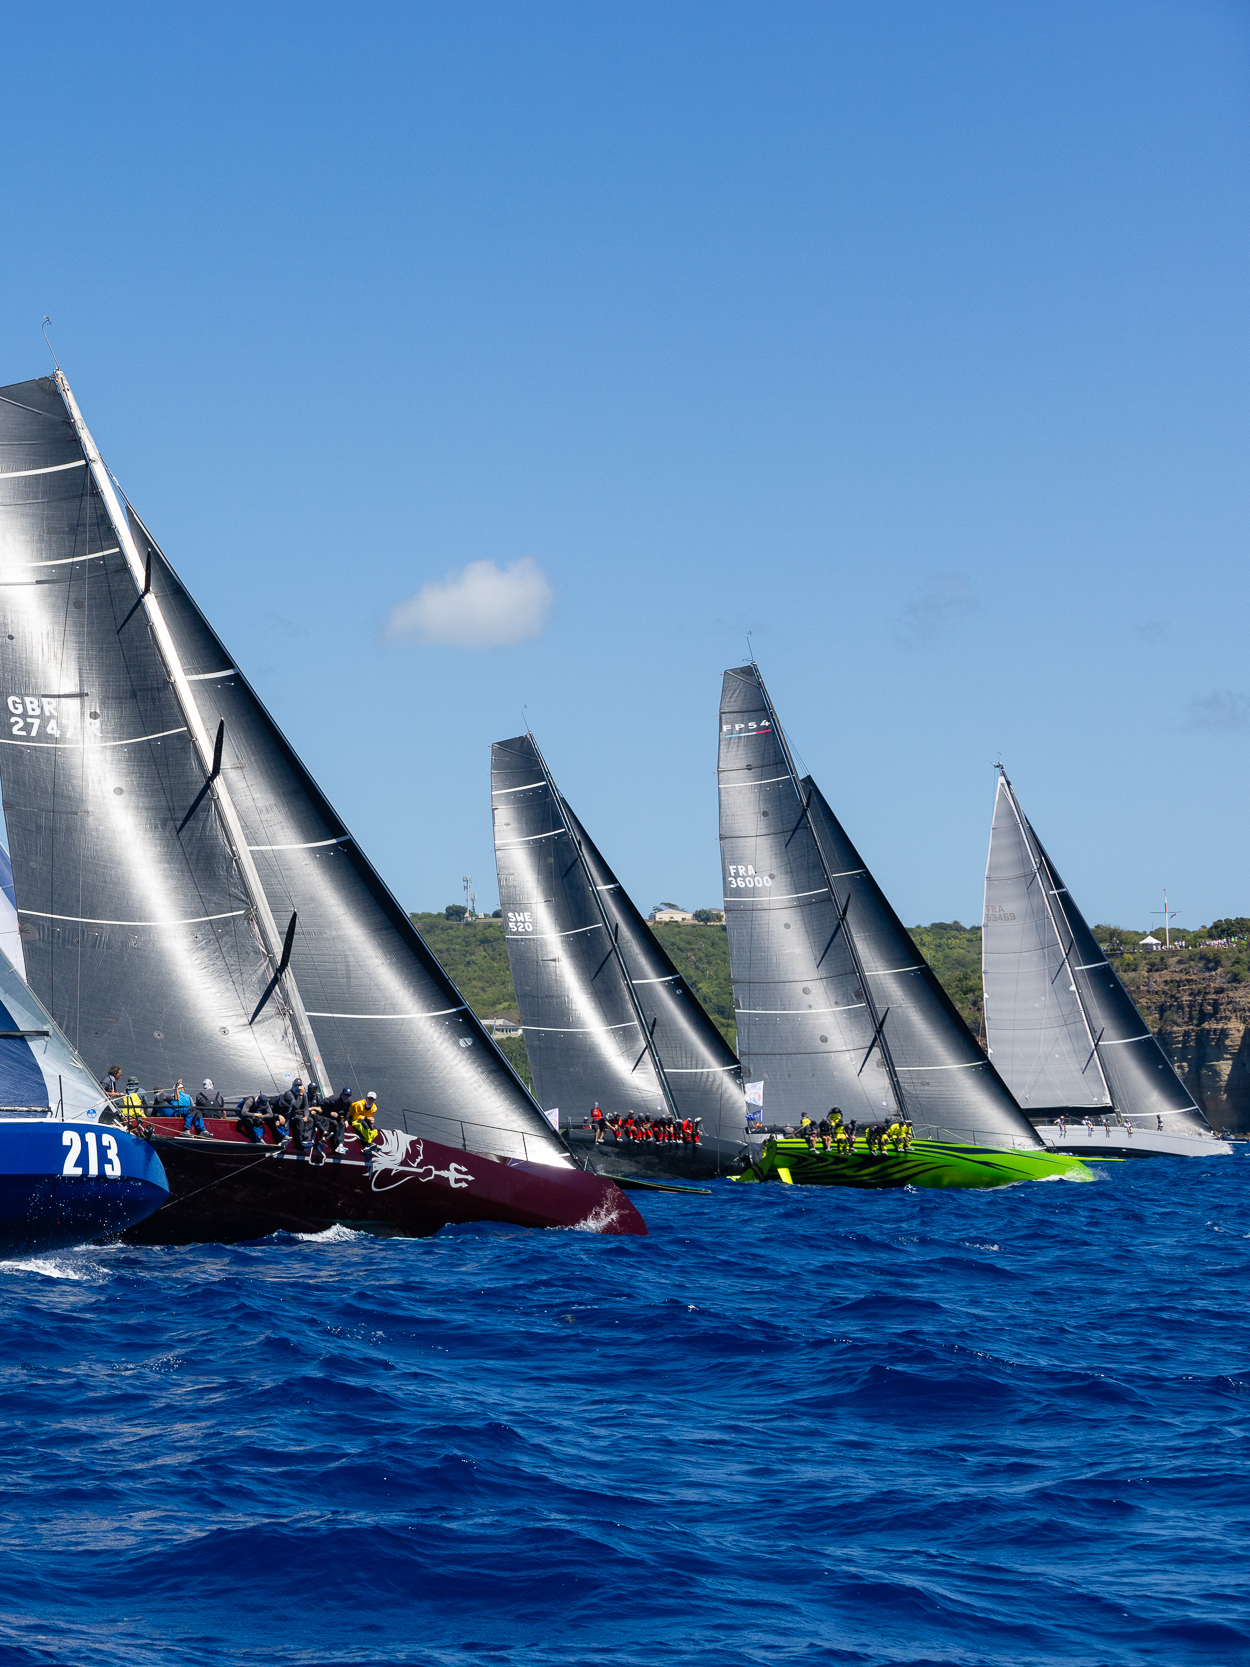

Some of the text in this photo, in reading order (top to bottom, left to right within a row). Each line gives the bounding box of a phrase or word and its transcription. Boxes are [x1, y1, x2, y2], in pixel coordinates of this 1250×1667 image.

[7, 695, 58, 716] GBR
[729, 864, 756, 876] FRA
[728, 876, 772, 888] 36000
[985, 904, 1005, 913] FRA
[507, 911, 533, 922] SWE
[508, 922, 533, 932] 520
[62, 1130, 122, 1179] 213
